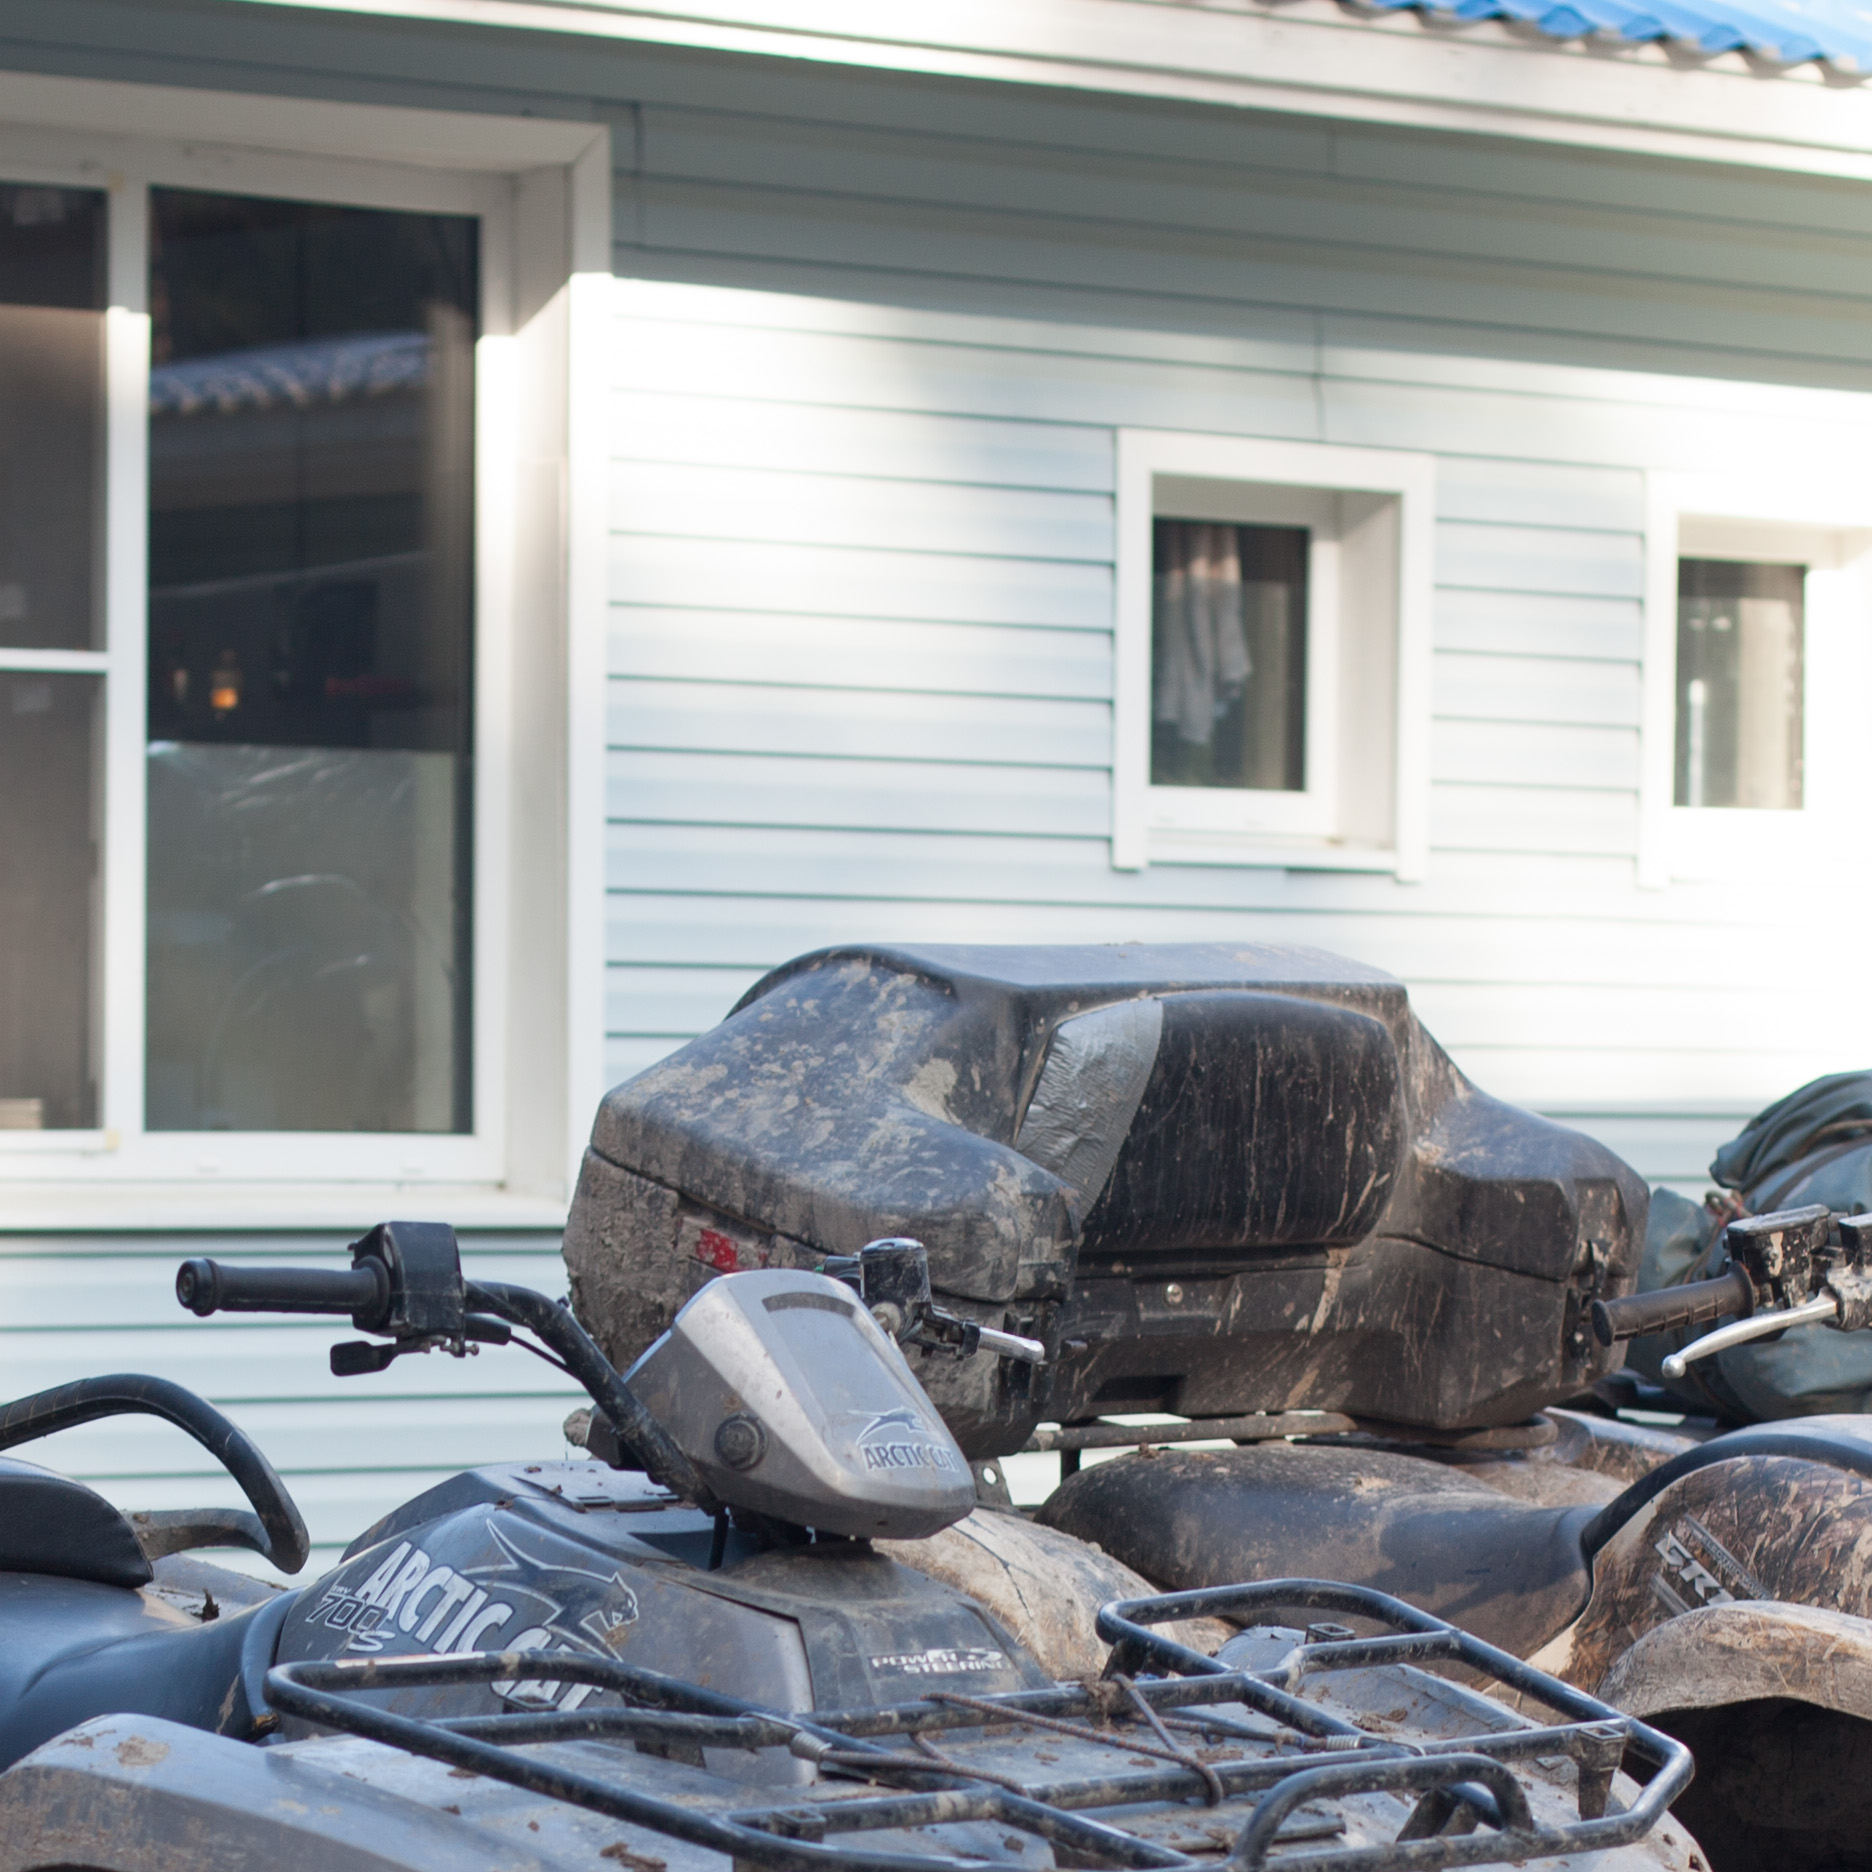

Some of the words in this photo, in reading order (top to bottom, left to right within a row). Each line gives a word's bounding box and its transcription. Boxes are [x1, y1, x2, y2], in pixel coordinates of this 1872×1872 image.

[859, 1441, 930, 1472] ARCTIC
[925, 1443, 960, 1473] CAT
[305, 1592, 389, 1635] 700
[354, 1541, 513, 1655] ARCTIC
